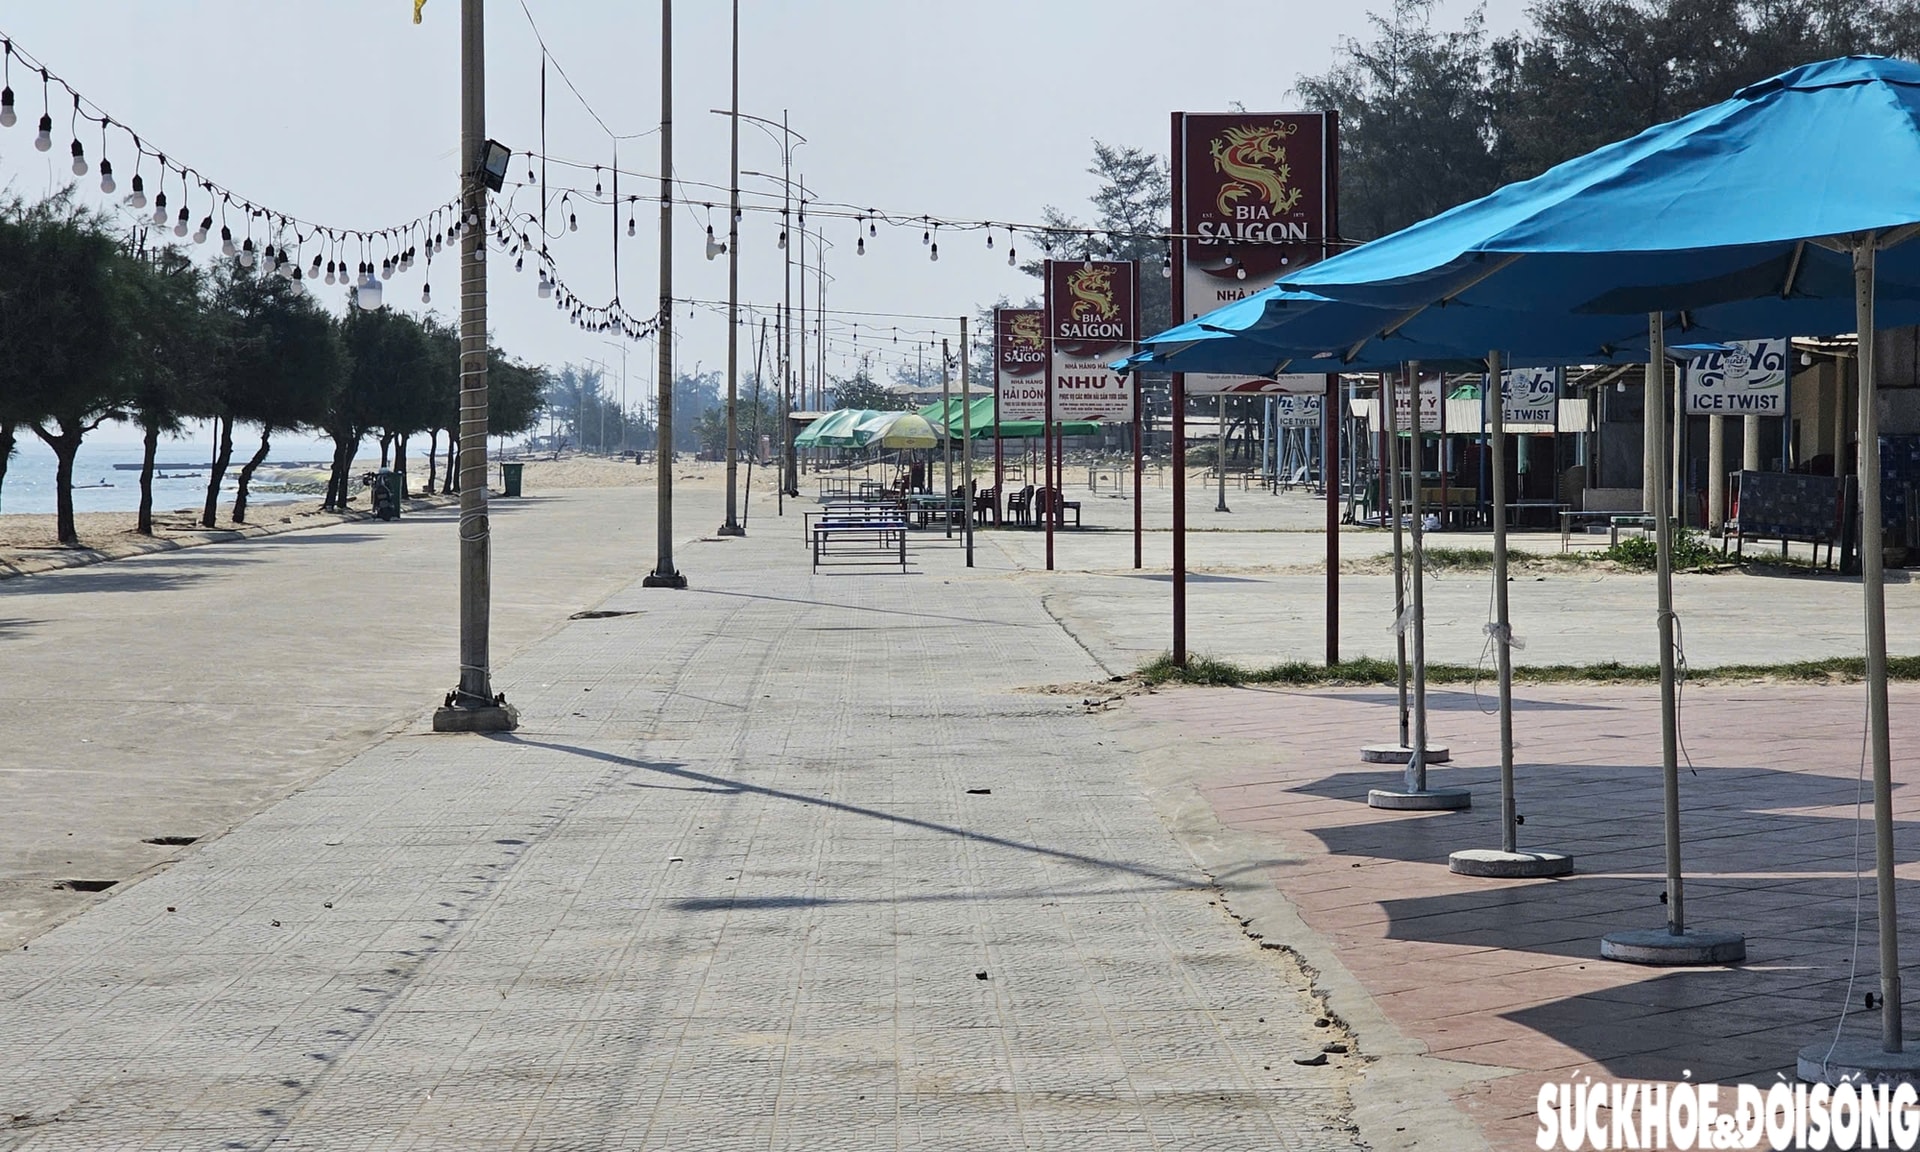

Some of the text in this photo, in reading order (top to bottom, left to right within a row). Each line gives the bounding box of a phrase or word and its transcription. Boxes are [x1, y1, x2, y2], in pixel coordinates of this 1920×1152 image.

[1236, 205, 1270, 220] BIA
[1197, 222, 1308, 245] SAIGON
[1082, 314, 1102, 323] BIA
[1060, 323, 1123, 337] SAIGON
[1058, 374, 1108, 389] NHƯ
[1003, 386, 1045, 400] HẢI DÒN
[1693, 394, 1778, 409] ICE TWIST
[1514, 409, 1550, 420] TWIST
